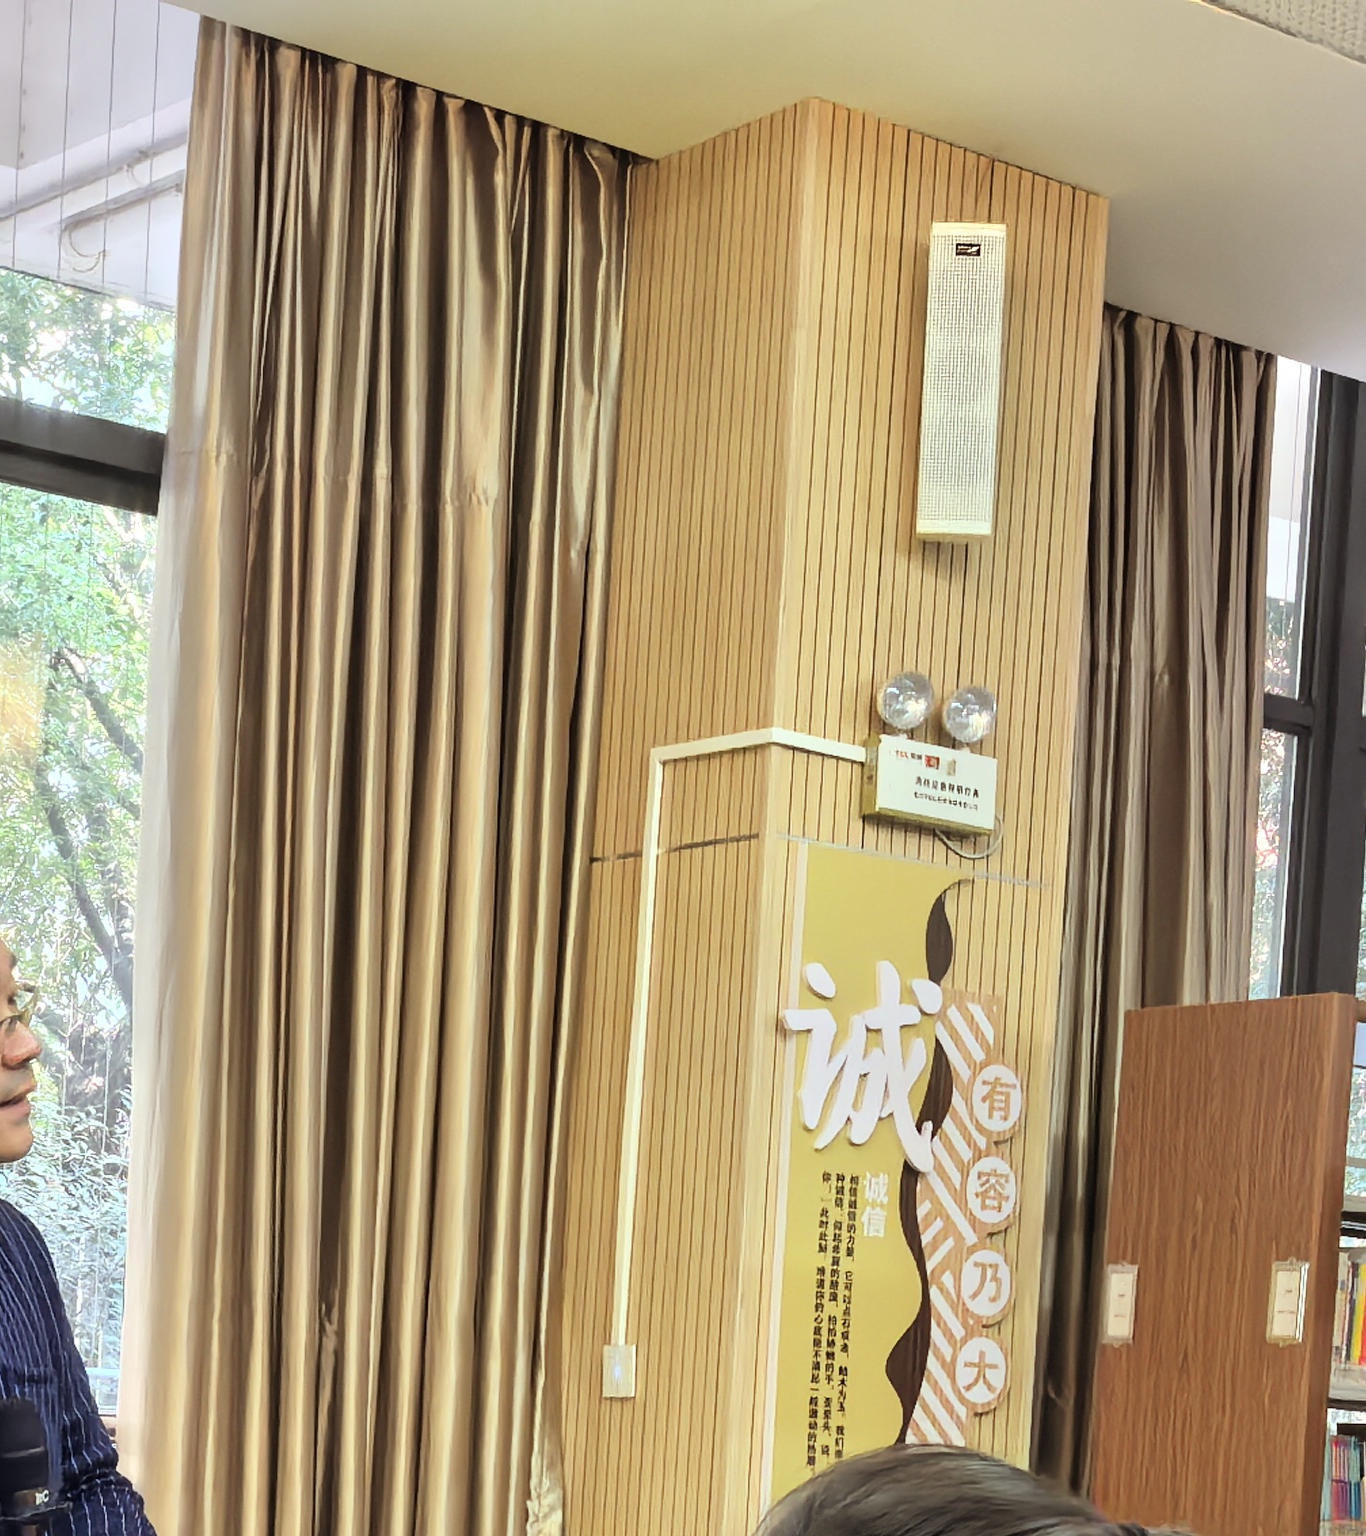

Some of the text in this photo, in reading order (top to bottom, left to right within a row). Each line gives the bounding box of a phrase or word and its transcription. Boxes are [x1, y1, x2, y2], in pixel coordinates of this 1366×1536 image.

[861, 1172, 889, 1238] 诚信
[962, 1076, 1017, 1393] 有容乃大
